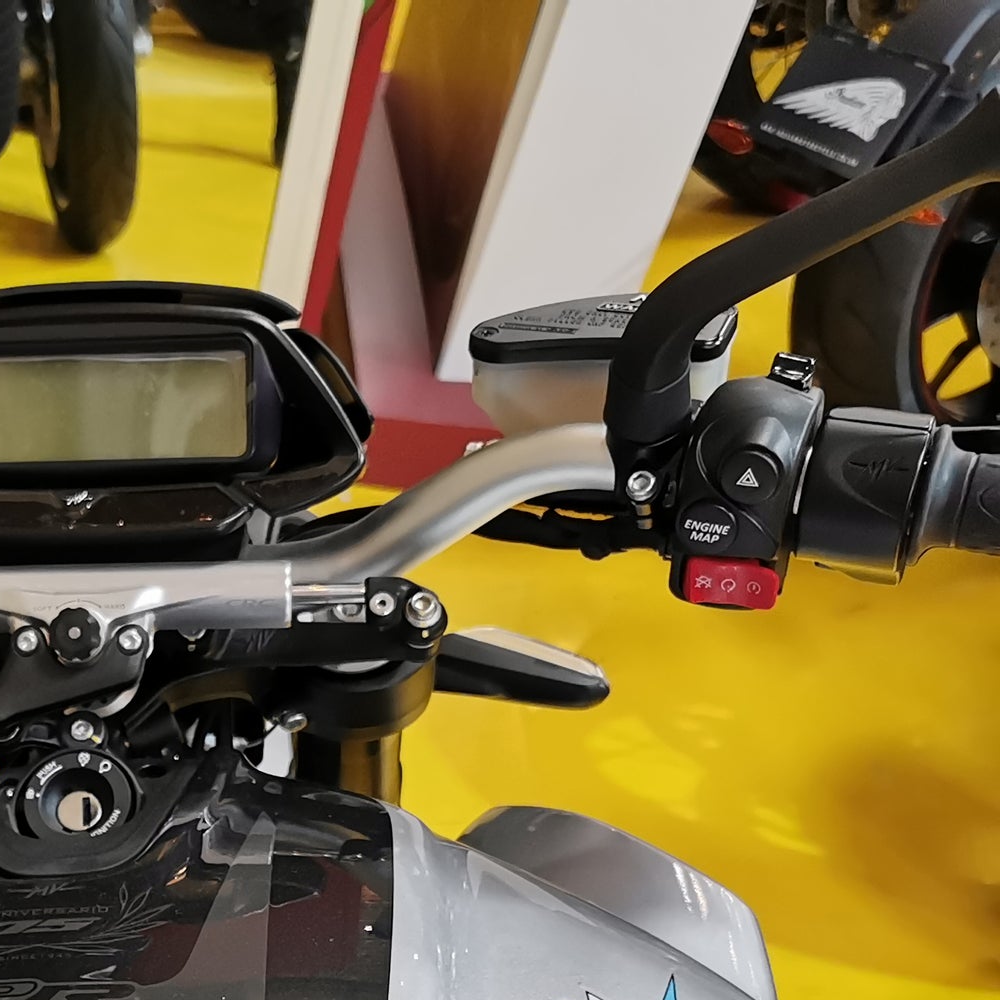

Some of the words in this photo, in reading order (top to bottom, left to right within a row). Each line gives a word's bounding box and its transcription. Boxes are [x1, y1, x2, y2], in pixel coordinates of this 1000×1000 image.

[684, 519, 731, 536] ENGINE
[689, 531, 720, 544] MAP
[36, 760, 59, 780] PUSH
